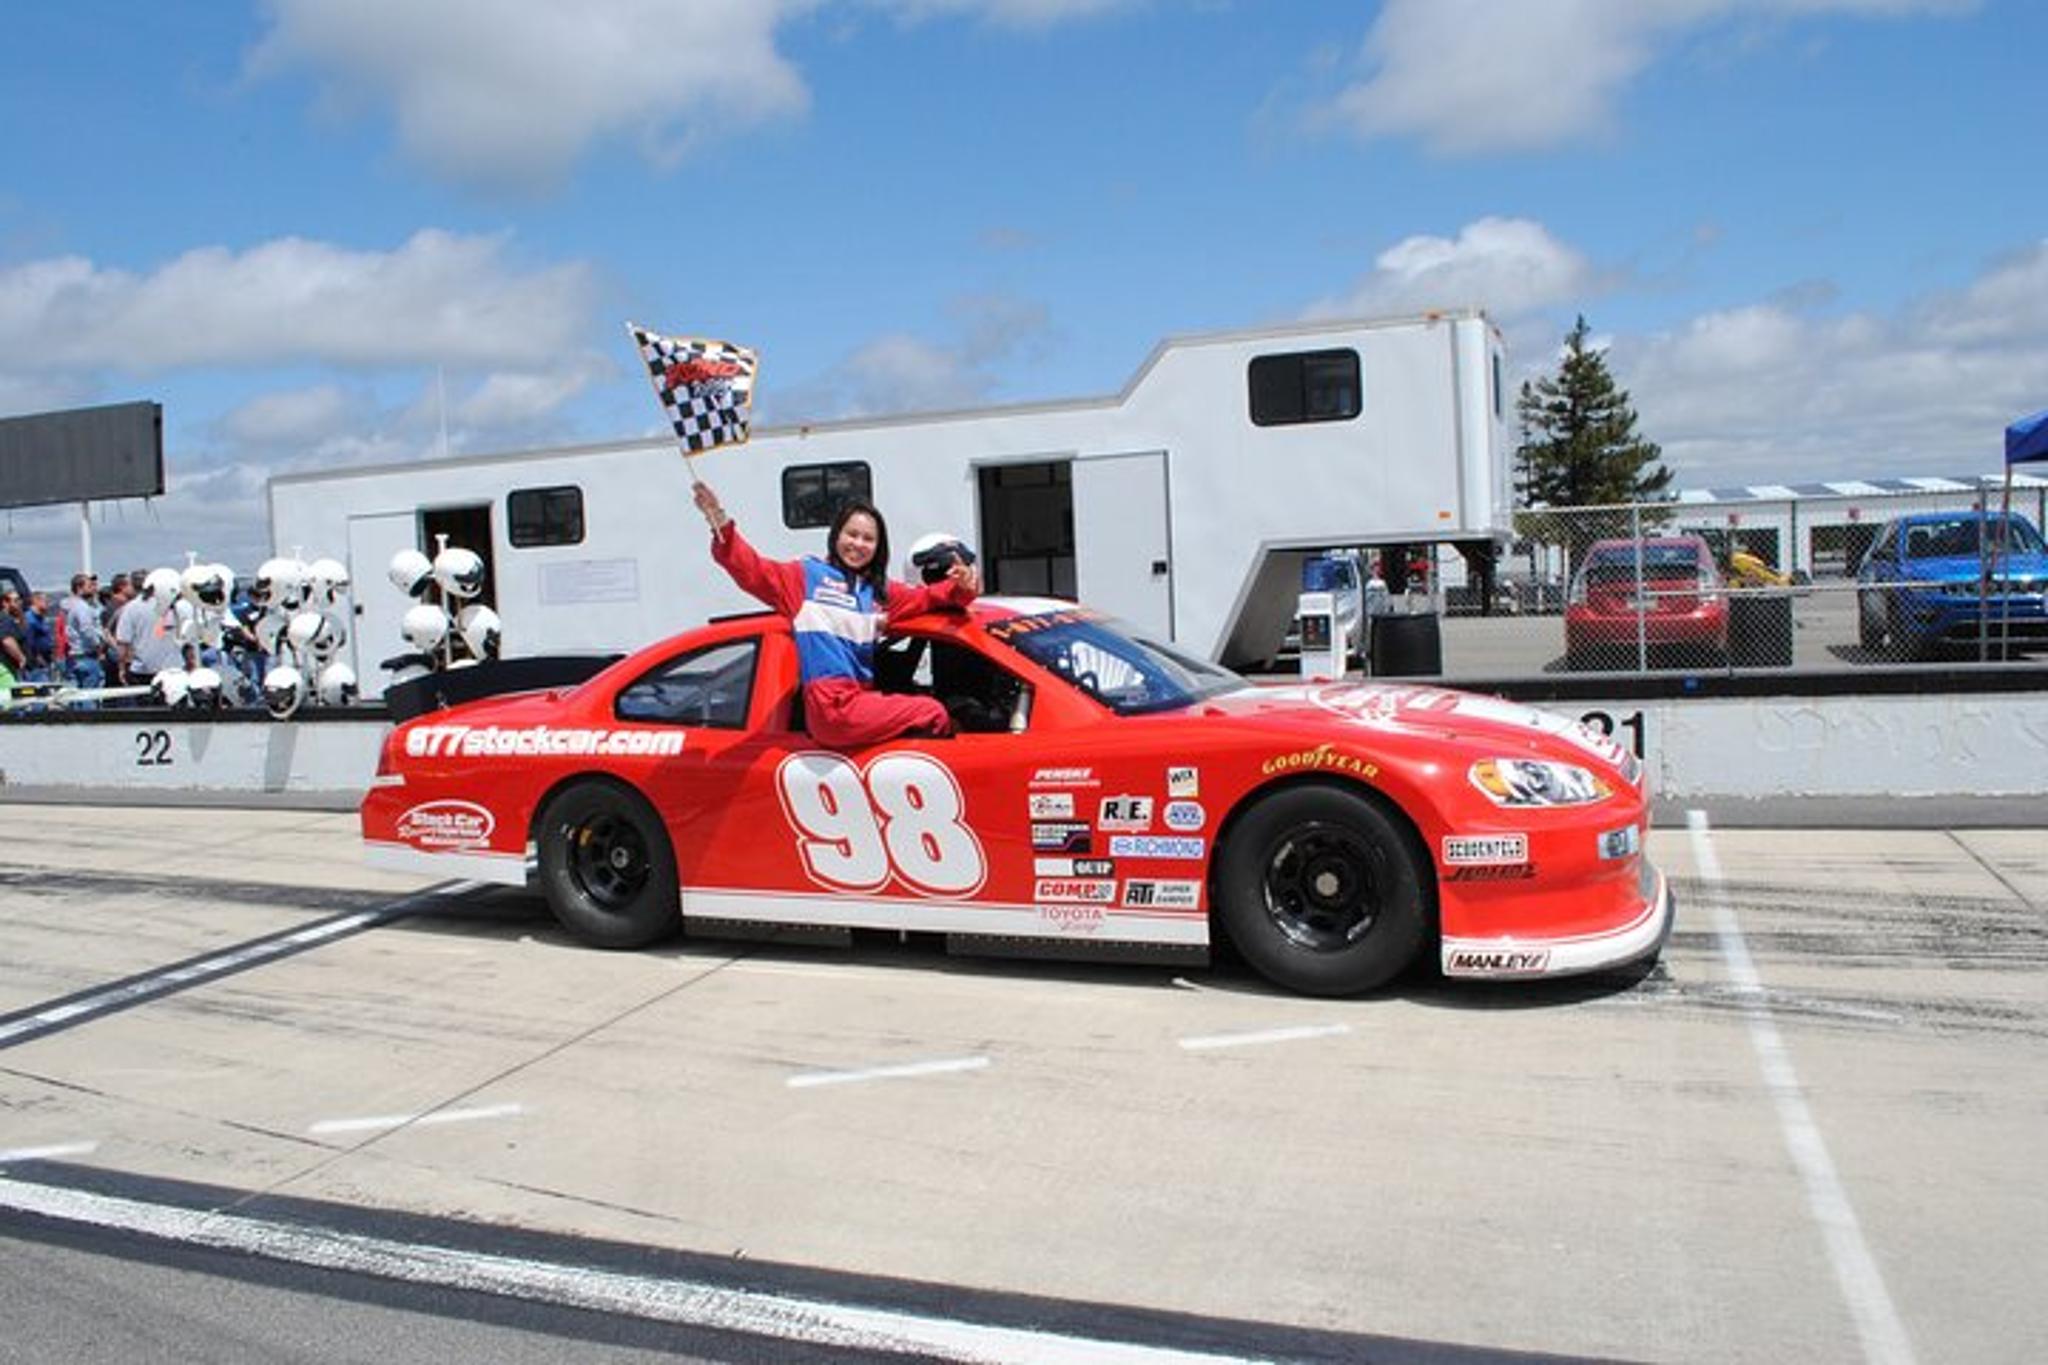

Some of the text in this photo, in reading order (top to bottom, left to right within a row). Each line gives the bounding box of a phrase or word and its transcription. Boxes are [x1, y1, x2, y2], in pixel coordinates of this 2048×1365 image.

[135, 730, 173, 766] 22
[1262, 742, 1378, 778] GOODYEAR
[775, 751, 988, 899] 98
[1041, 907, 1103, 920] TOYOTA
